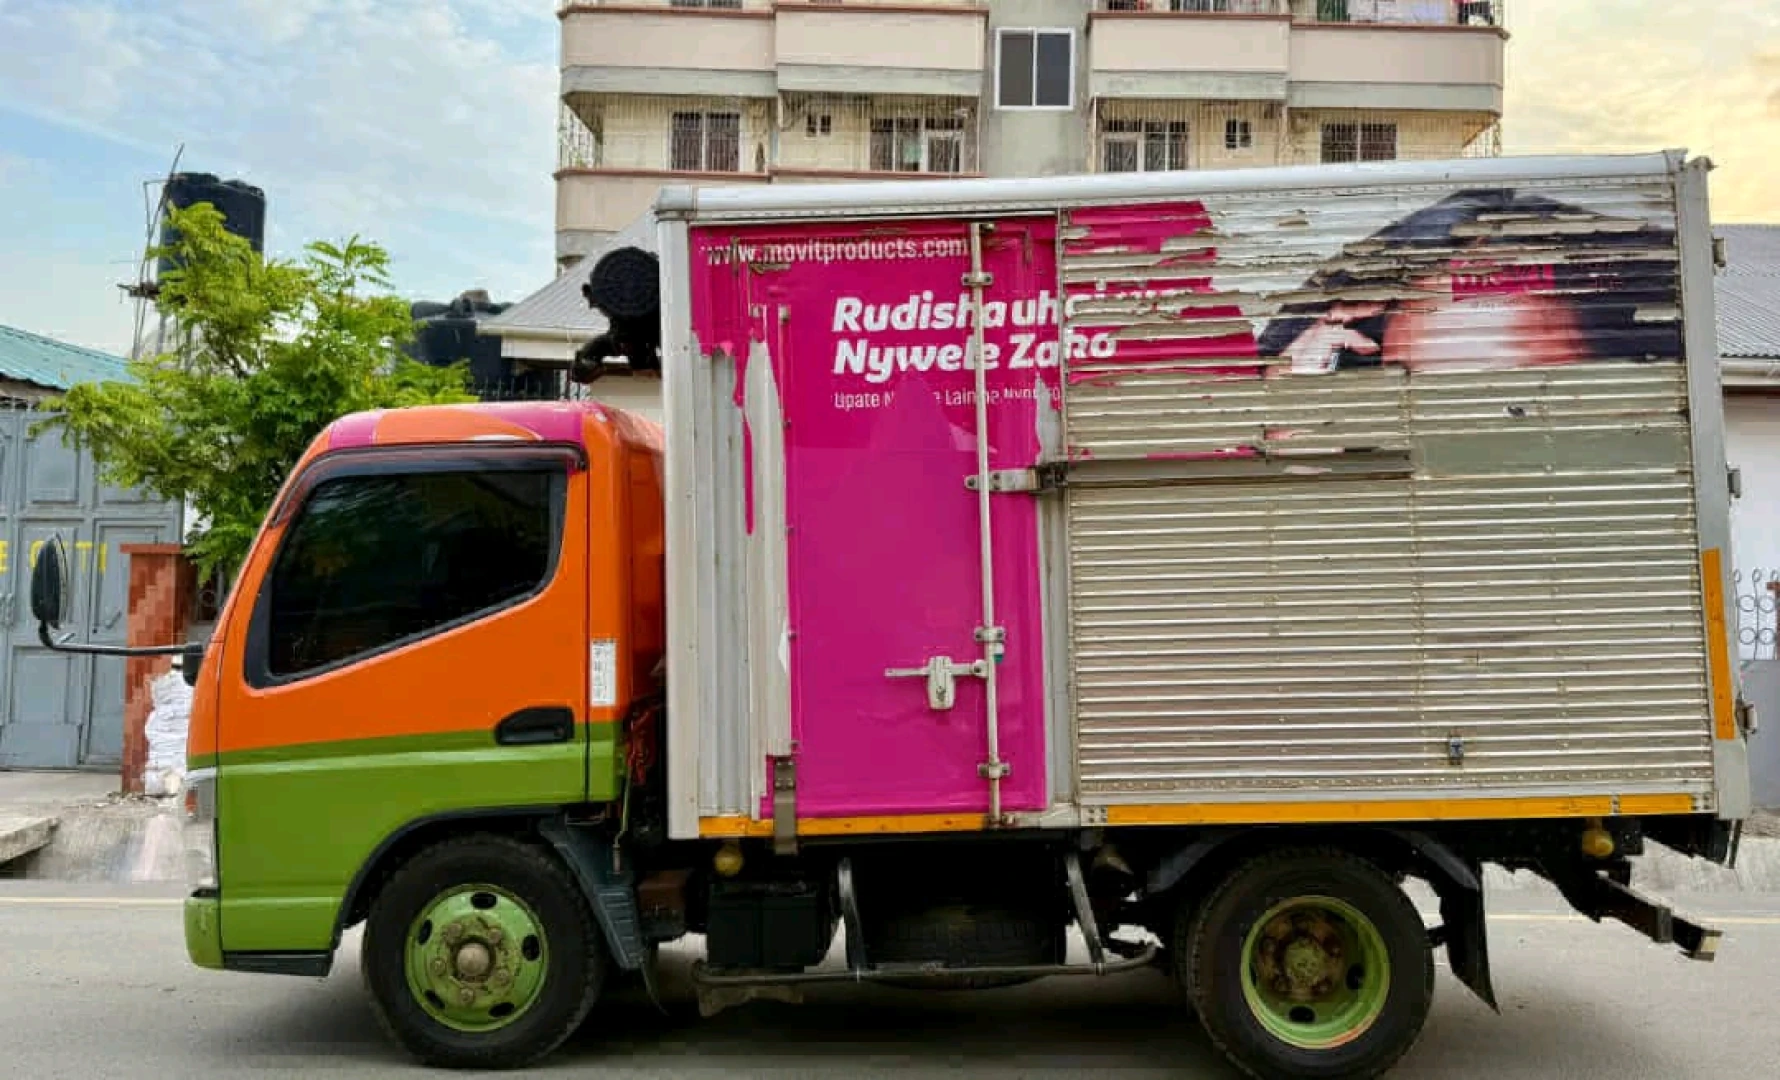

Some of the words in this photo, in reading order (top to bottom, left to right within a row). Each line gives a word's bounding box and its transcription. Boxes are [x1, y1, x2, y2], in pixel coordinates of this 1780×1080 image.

[832, 290, 1007, 332] Rudisha
[834, 335, 1000, 383] Nywele
[834, 390, 881, 411] Upate
[945, 387, 979, 406] Lain
